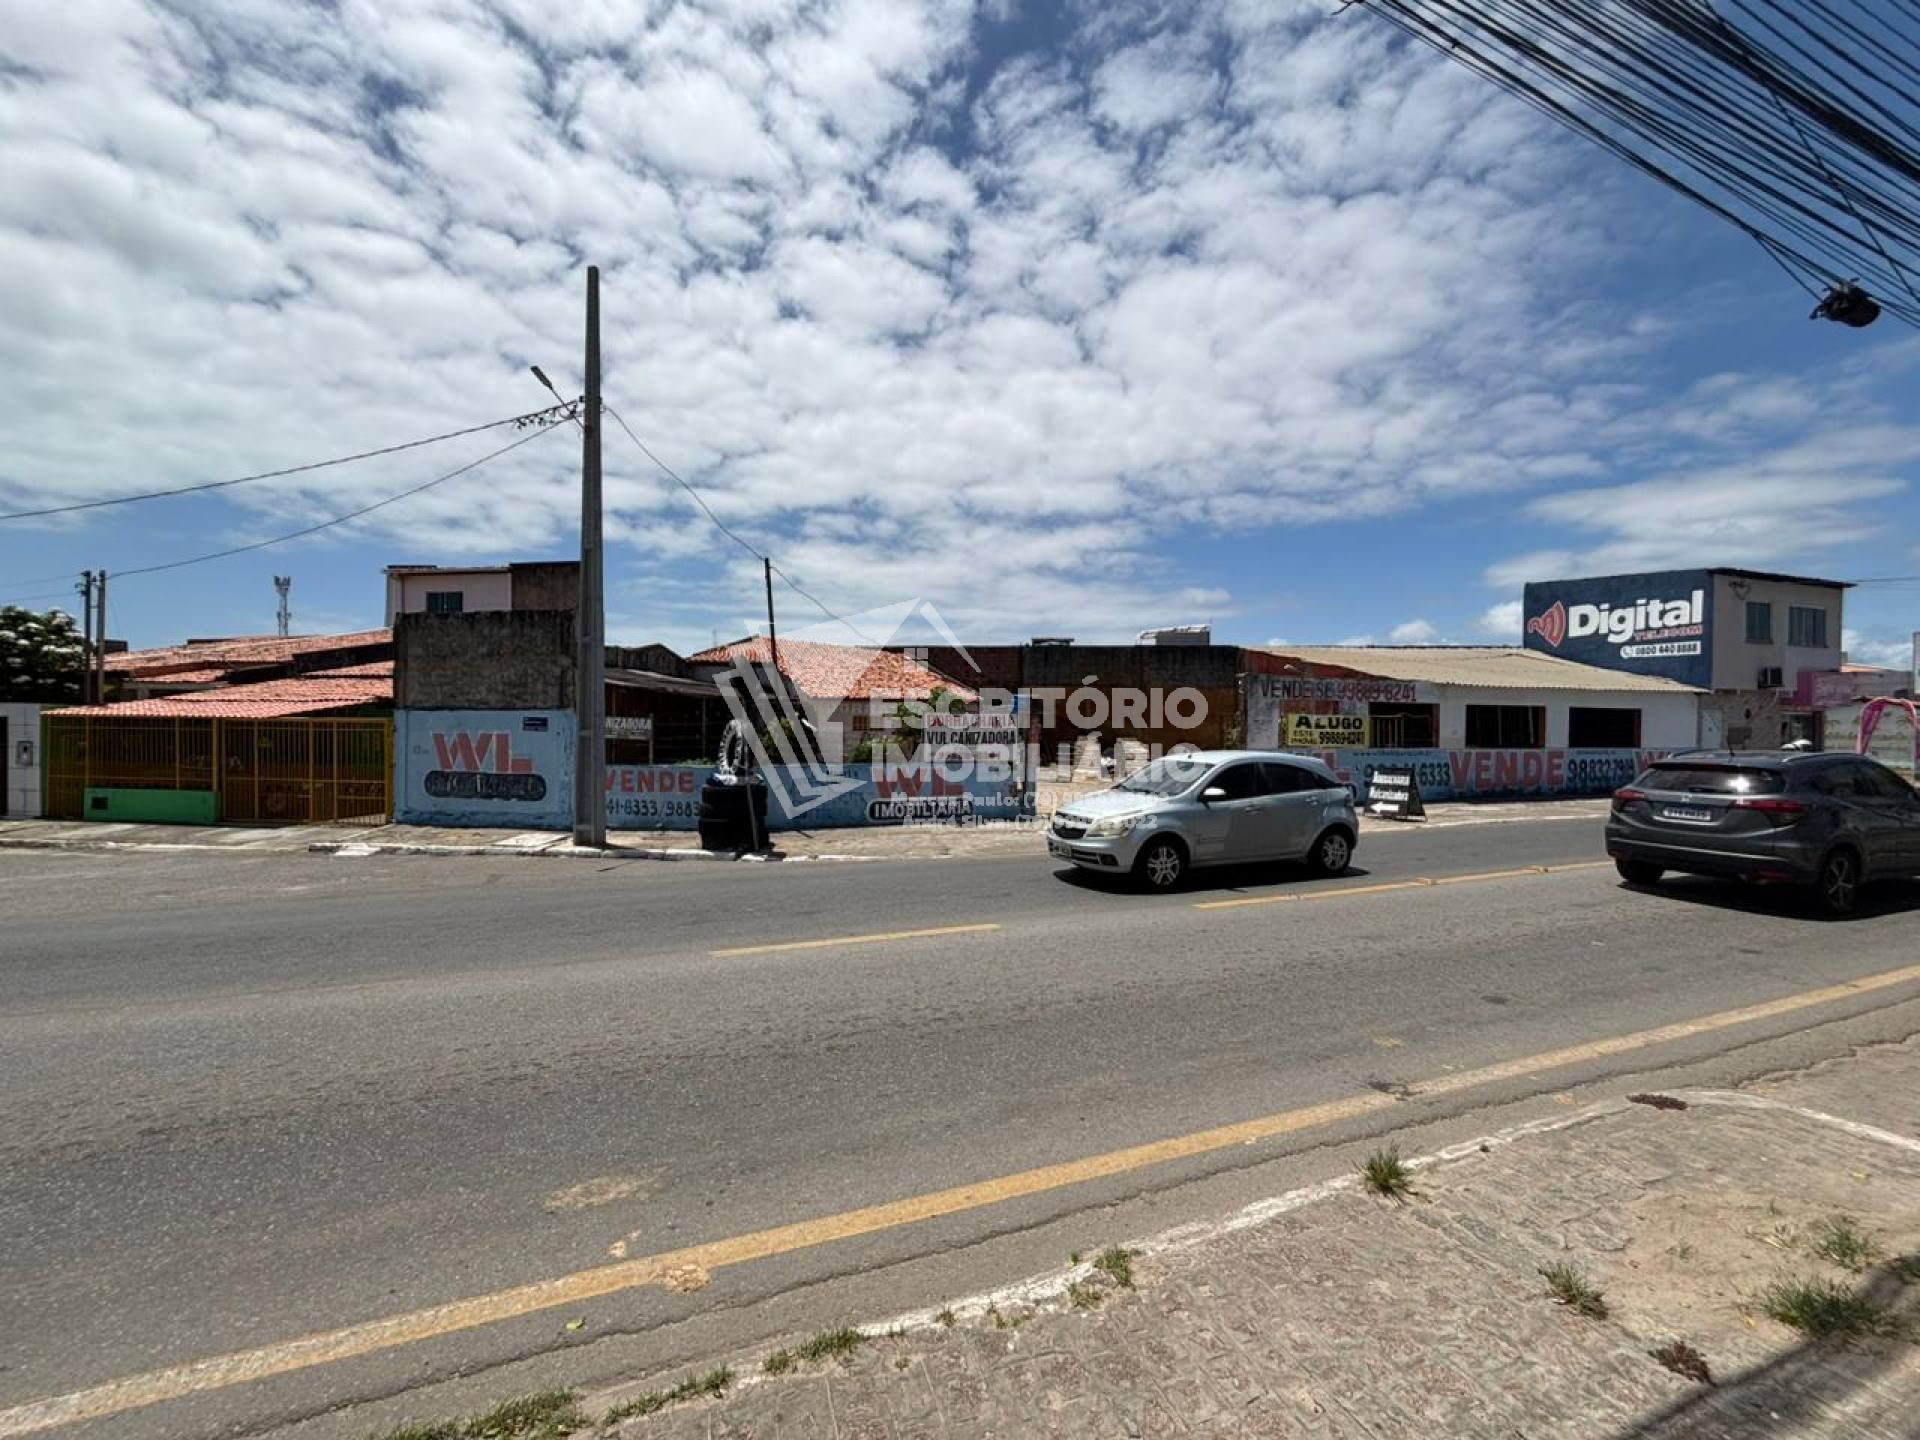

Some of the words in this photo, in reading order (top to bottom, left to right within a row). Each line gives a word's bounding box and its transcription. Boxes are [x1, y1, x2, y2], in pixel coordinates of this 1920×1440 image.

[1569, 590, 1703, 643] Digital
[927, 731, 1016, 744] VULCANIZADORA
[1296, 716, 1363, 730] ALUGO
[431, 731, 533, 772] WL
[1450, 752, 1564, 788] VENDE
